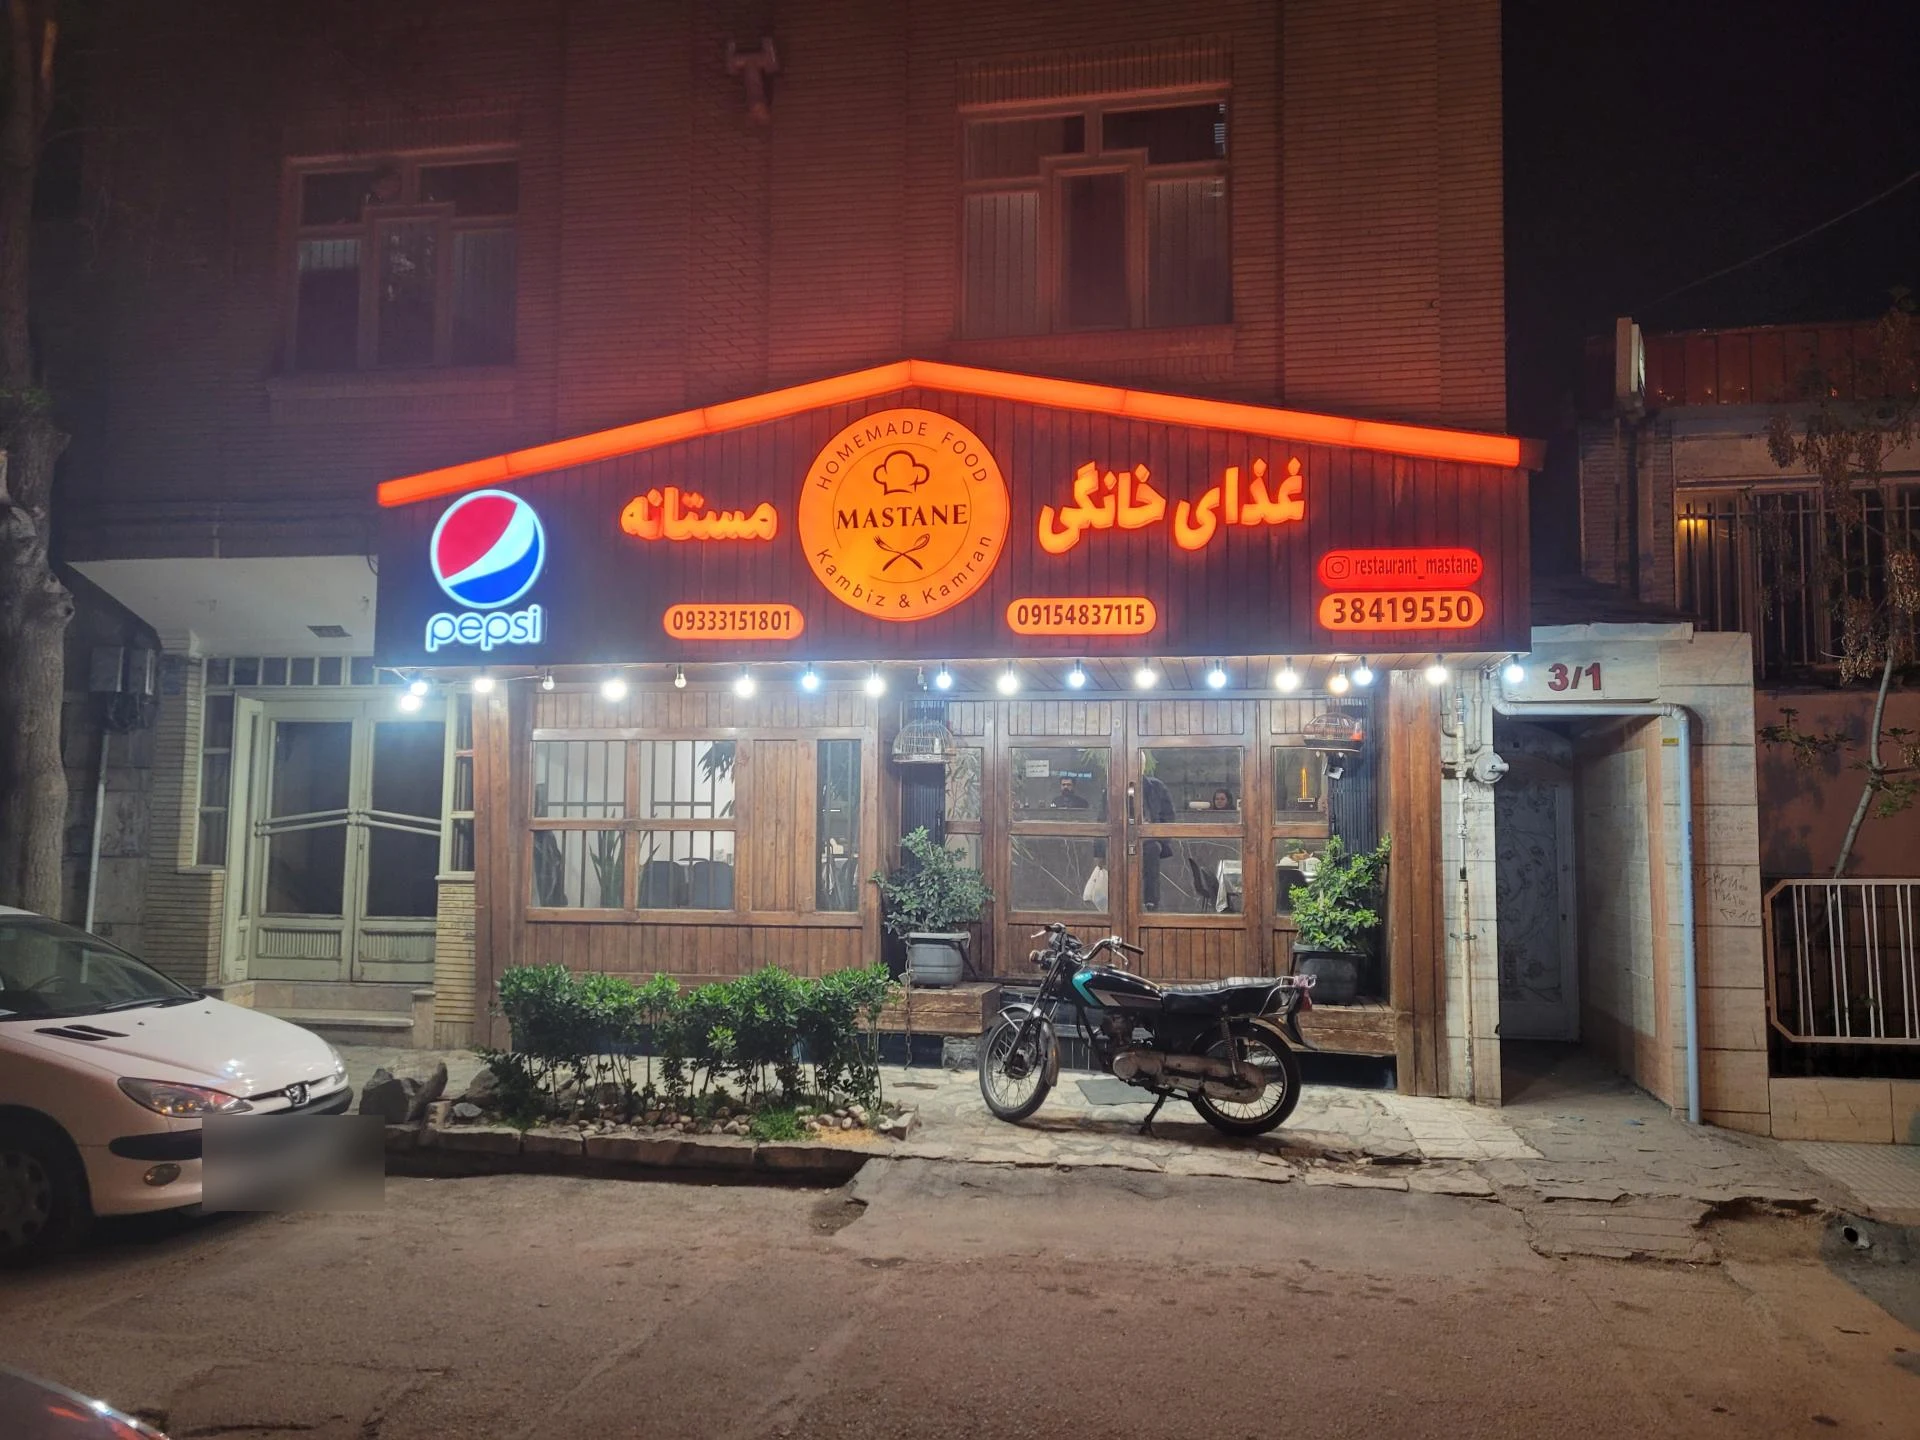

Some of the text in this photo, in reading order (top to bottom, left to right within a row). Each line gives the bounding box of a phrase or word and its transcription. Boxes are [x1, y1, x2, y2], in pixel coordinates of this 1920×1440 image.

[816, 420, 987, 490] HOMEMADE FOOD
[620, 486, 778, 540] مستانه
[836, 503, 968, 530] MASTANE
[1038, 456, 1305, 554] غذای خانگی
[816, 536, 992, 609] Kambiz & Kamran
[1355, 554, 1478, 580] restaurant_mastane
[673, 610, 791, 631] 09333151801
[1017, 604, 1145, 626] 09154837115
[1333, 596, 1473, 624] 38419550
[425, 604, 541, 652] pepsi
[1547, 662, 1602, 692] 3/1
